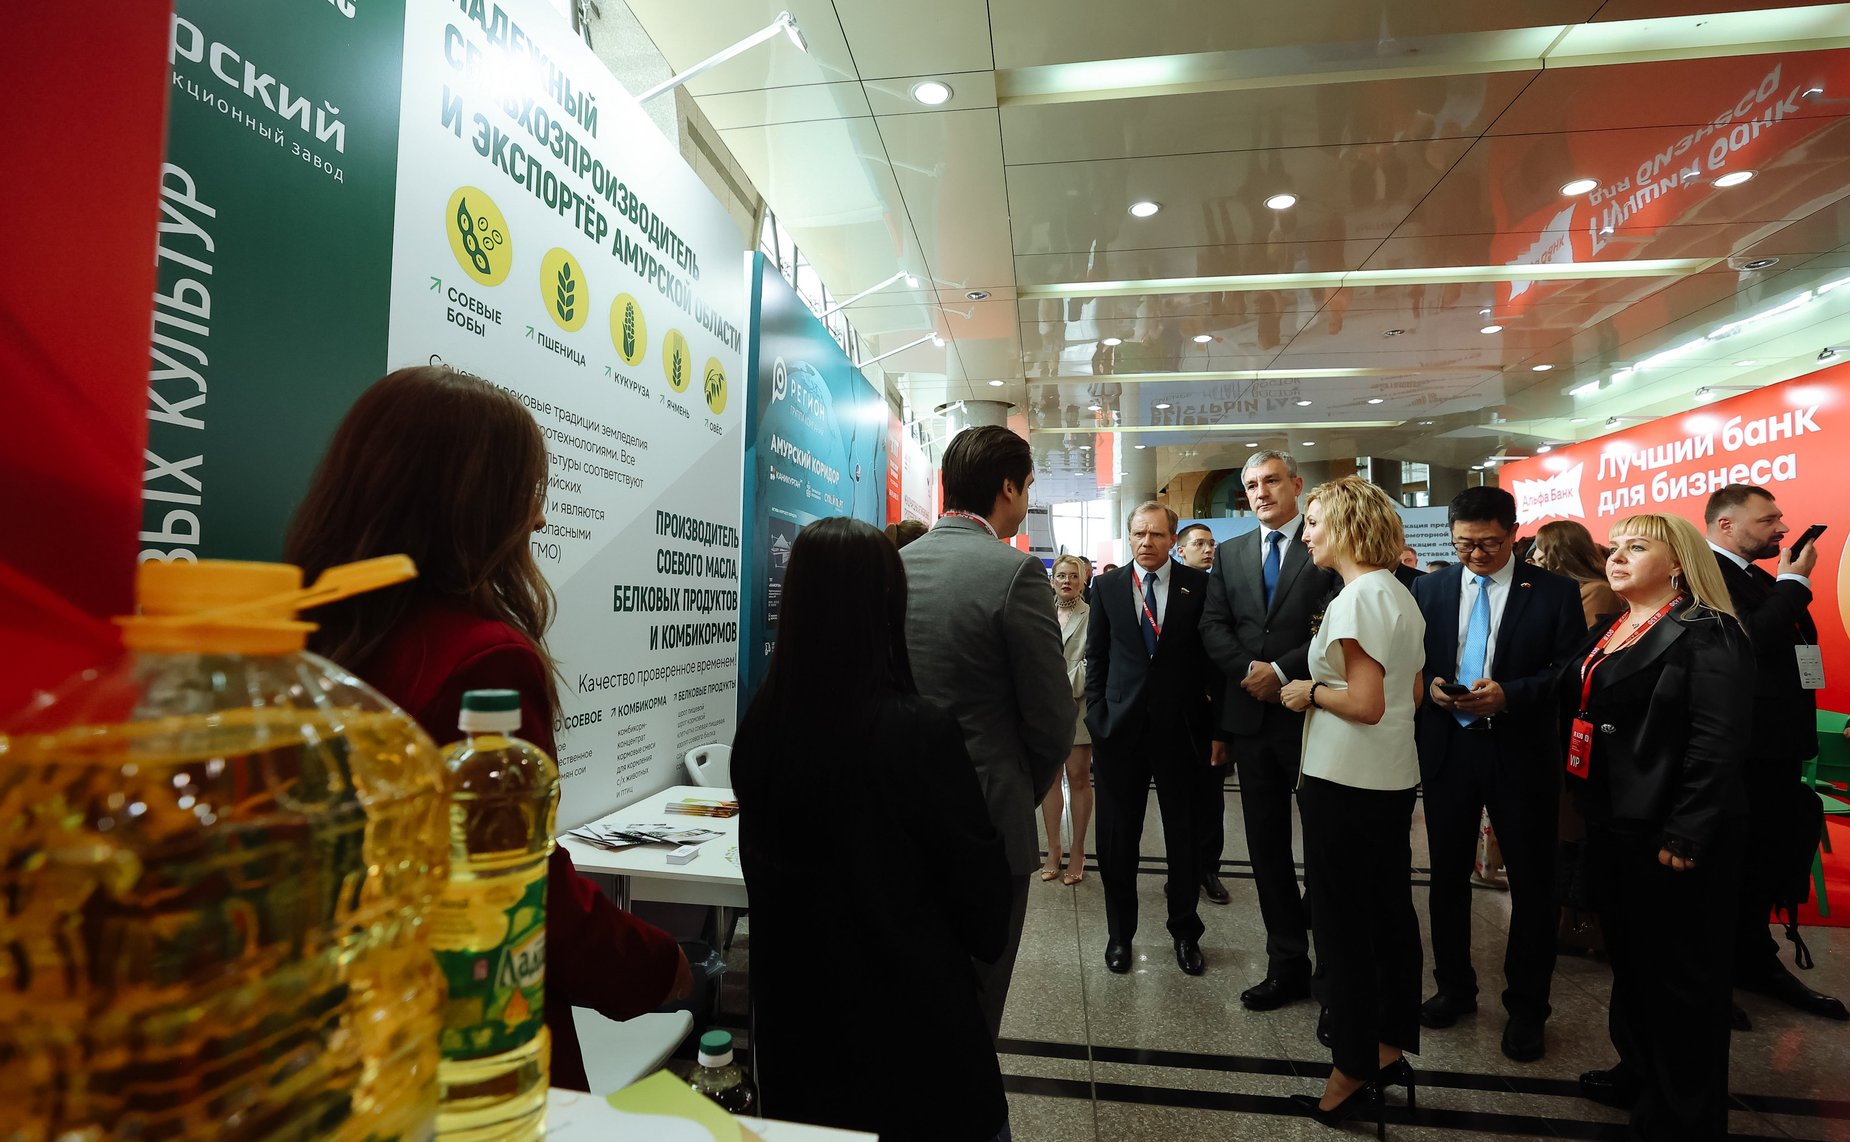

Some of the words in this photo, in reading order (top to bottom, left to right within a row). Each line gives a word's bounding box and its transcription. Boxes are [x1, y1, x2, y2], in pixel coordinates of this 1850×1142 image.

[452, 0, 598, 139] АДЕНЫЙ
[290, 141, 345, 184] завод
[441, 84, 464, 139] И
[472, 112, 608, 246] ЭКСПОРТЁР
[612, 228, 692, 317] АМУРСКОЙ
[695, 295, 742, 356] ОБЛАСТИ
[146, 162, 217, 430] КУЛЬТУР
[447, 287, 502, 326] СОЕВЫЕ
[446, 307, 486, 337] БОБЫ
[537, 332, 587, 368] ПШЕНИЦА
[614, 371, 651, 400] КУКУРУЗА
[791, 379, 825, 421] РЕГИОН
[666, 399, 691, 419] ЯЧМЕНЬ
[554, 406, 600, 433] традиции
[601, 424, 648, 451] земледелия
[709, 421, 723, 436] ОВЁС
[1721, 404, 1822, 453] банк
[620, 449, 636, 466] Все
[770, 433, 811, 471] АМУРСКИЙ
[811, 456, 840, 485] КОРИДОР
[583, 462, 644, 489] соответствуют
[1597, 484, 1646, 517] для
[1651, 452, 1798, 502] бизнеса
[551, 501, 559, 512] и
[560, 503, 605, 521] являются
[1522, 493, 1550, 508] Альфа
[1551, 487, 1574, 501] Банк
[656, 510, 739, 549] ПРОИЗВОДИТЕЛЬ
[656, 548, 703, 577] СОЕВОГО
[705, 555, 739, 583] МАСЛА,
[613, 585, 680, 612] БЕЛКОВЫХ
[682, 589, 738, 614] ПРОДУКТОВ
[649, 625, 659, 651] И
[661, 621, 738, 649] КОМБИКОРМОВ
[578, 672, 636, 694] Качество
[637, 662, 696, 687] проверенное
[697, 652, 737, 678] временем!
[678, 686, 708, 702] БЕЛКОВЫЕ
[708, 680, 737, 694] ПРОДУКТЫ
[564, 709, 603, 730] СОЕВОЕ
[617, 695, 668, 718] КОМБИКОРМА
[617, 734, 646, 750] концентрат
[616, 763, 627, 775] для
[1570, 754, 1580, 768] VIP
